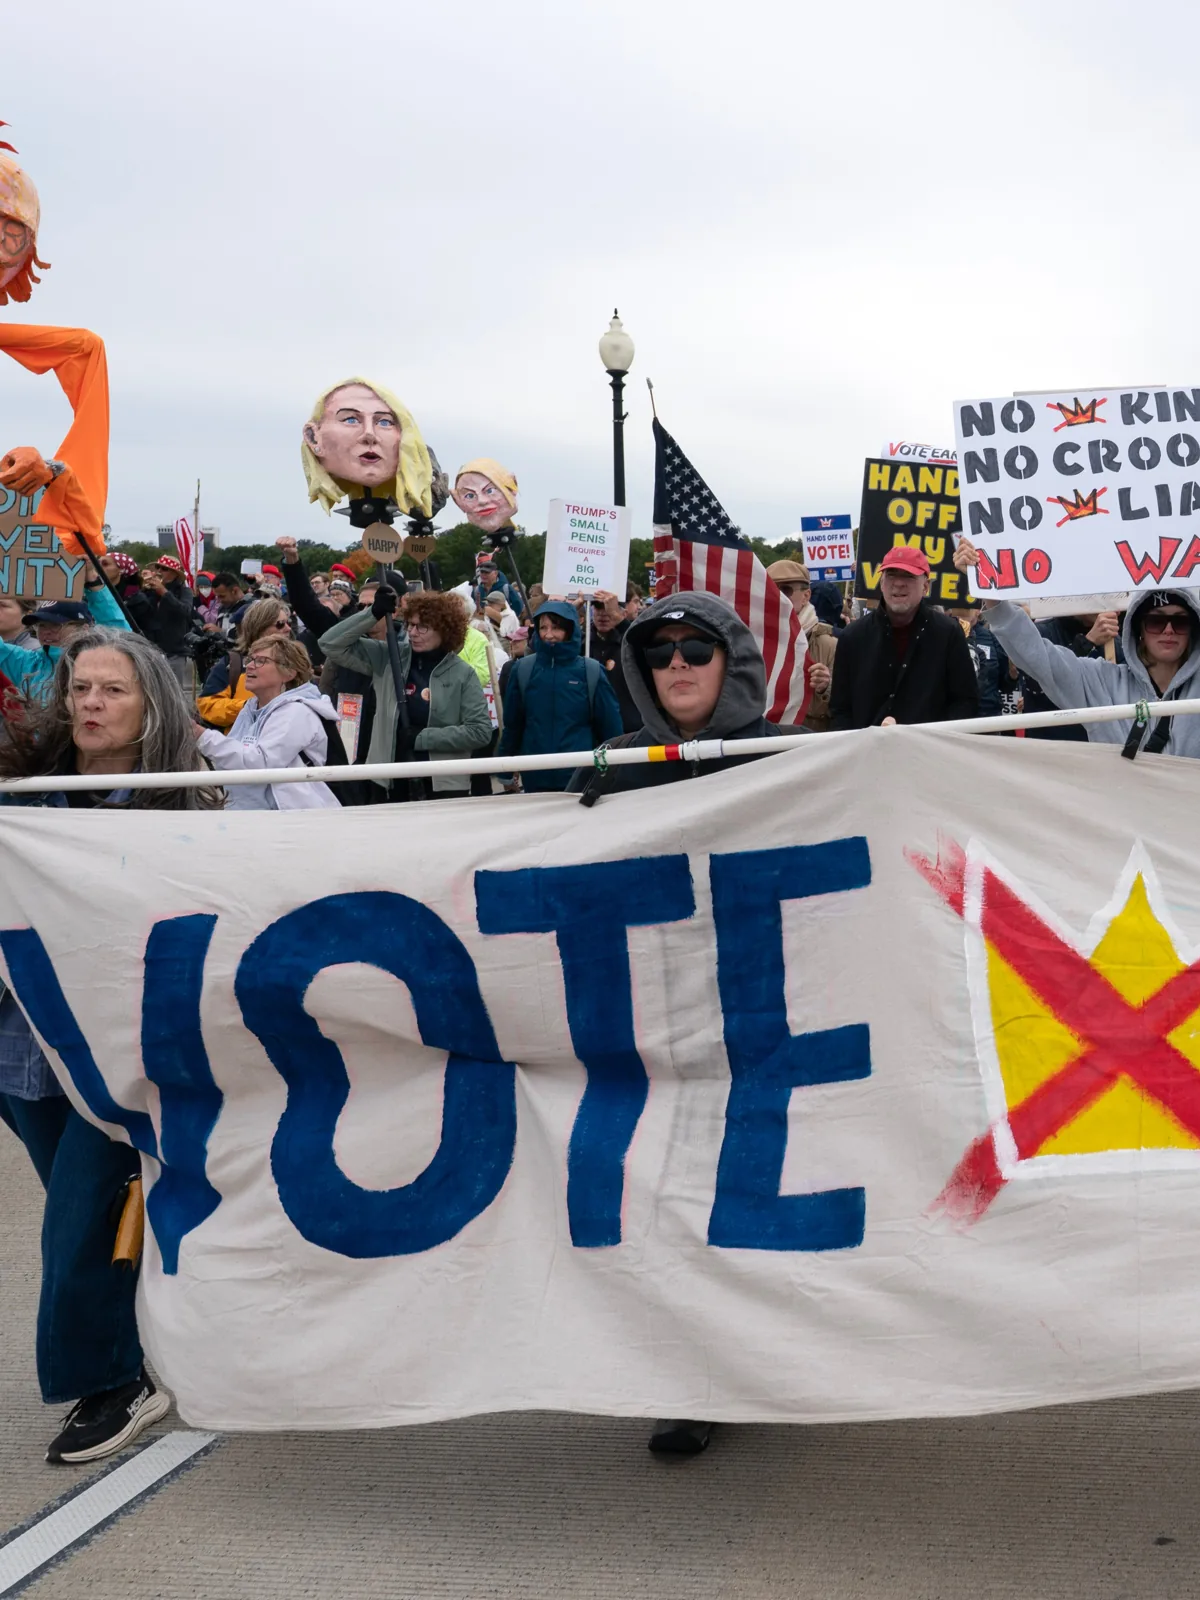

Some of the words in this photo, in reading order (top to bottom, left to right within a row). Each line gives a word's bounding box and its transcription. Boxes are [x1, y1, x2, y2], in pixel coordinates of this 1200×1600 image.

[960, 399, 1036, 438] NO
[889, 441, 927, 459] VOTE
[963, 445, 1039, 484] NO
[565, 504, 617, 520] TRUMP'S
[887, 497, 958, 531] OFF
[968, 495, 1043, 535] NO
[569, 518, 609, 532] SMALL
[368, 538, 399, 554] HARPY
[570, 531, 606, 545] PENIS
[806, 534, 825, 542] HANDS
[827, 533, 838, 541] OFF
[839, 533, 848, 541] MY
[567, 545, 606, 556] REQUIRES
[807, 544, 850, 561] VOTE!
[576, 564, 595, 574] BIG
[974, 548, 1052, 589] NO
[569, 575, 600, 586] ARCH
[0, 836, 871, 1275] VOTE
[126, 1386, 150, 1417] HOKA
